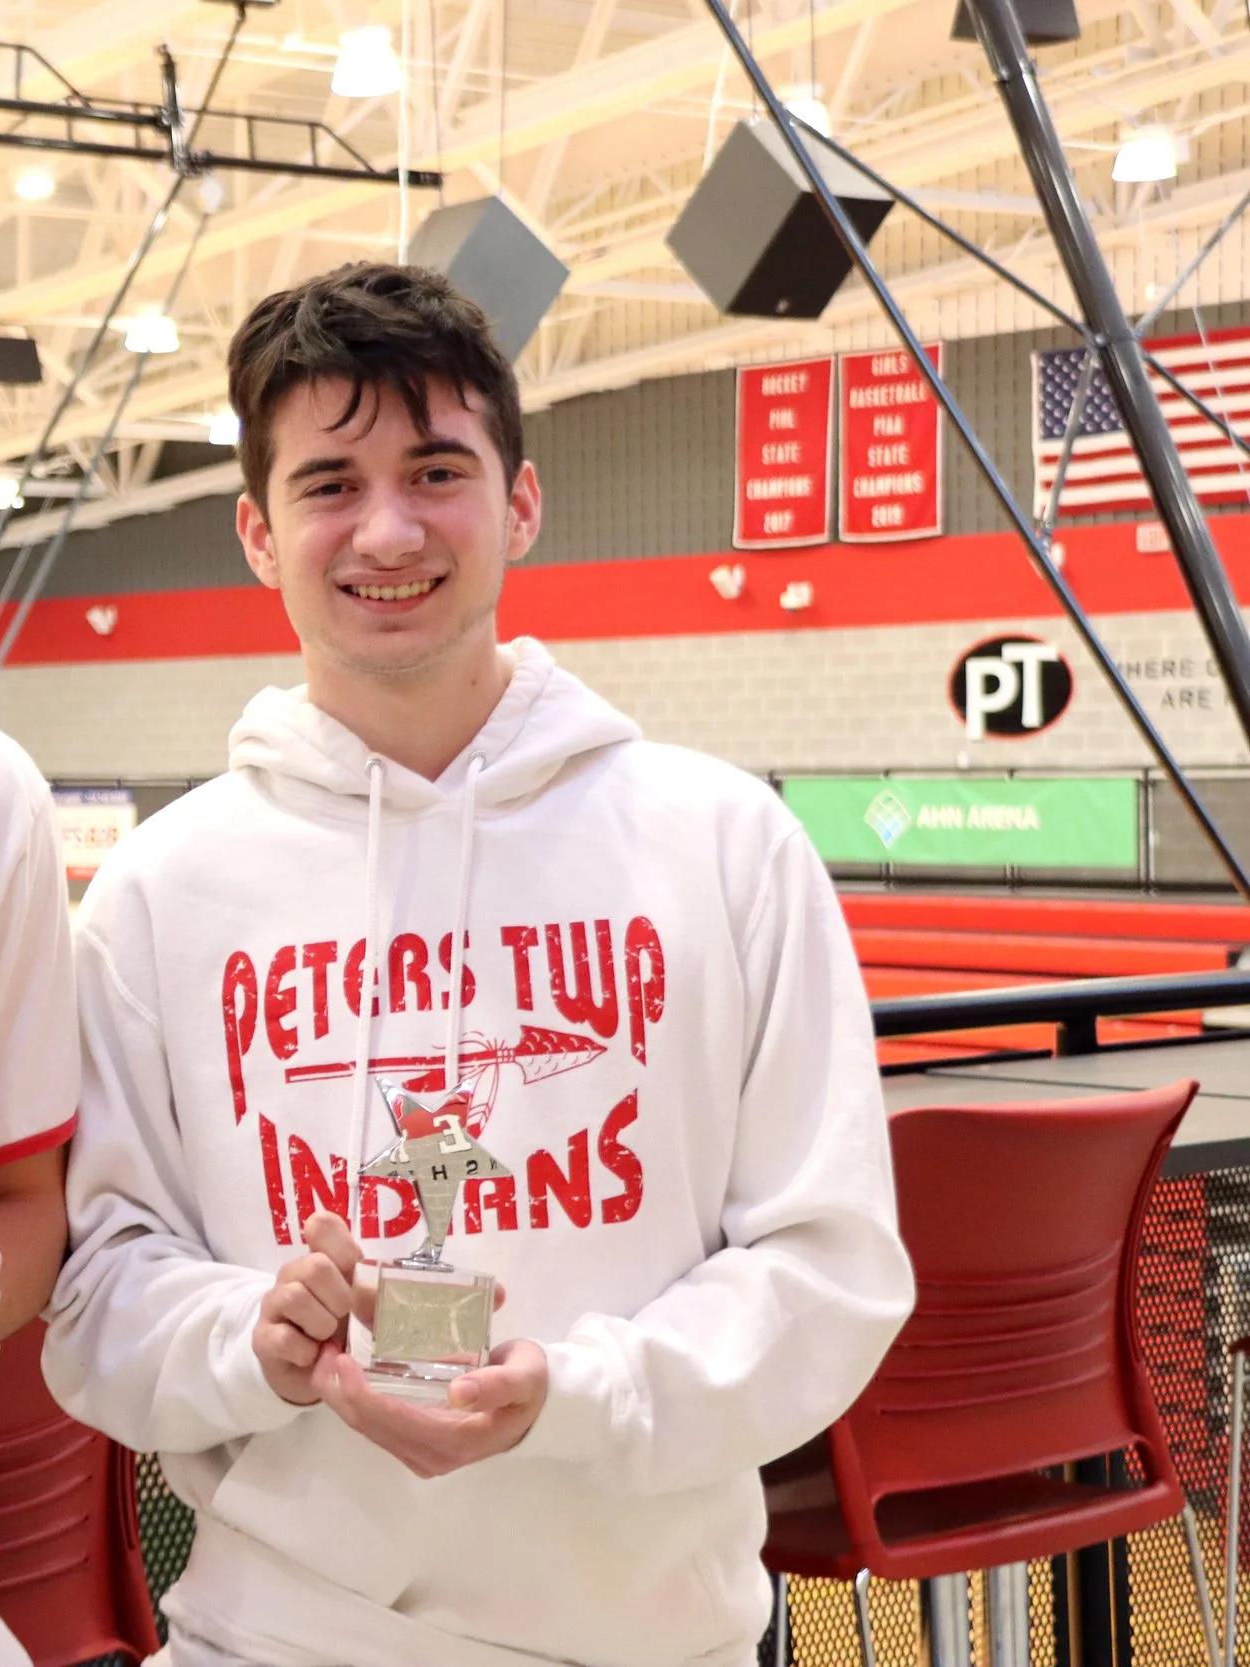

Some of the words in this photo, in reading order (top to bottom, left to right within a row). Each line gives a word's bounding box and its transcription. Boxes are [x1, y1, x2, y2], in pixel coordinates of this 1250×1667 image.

[871, 355, 910, 377] GIRLS
[761, 371, 808, 396] HOCKEY
[849, 383, 927, 409] BASKETBALL
[873, 415, 905, 437] PIAA
[762, 441, 801, 466] STATE
[867, 443, 910, 468] STATE
[746, 476, 811, 500] CHAMPIONS
[853, 473, 924, 498] CHAMPIONS
[1160, 687, 1212, 710] ARE
[916, 804, 963, 829] AHN
[966, 804, 1041, 830] ARENA
[222, 930, 477, 1127] PETERS
[499, 915, 665, 1067] TWP
[257, 1087, 644, 1246] INDANS
